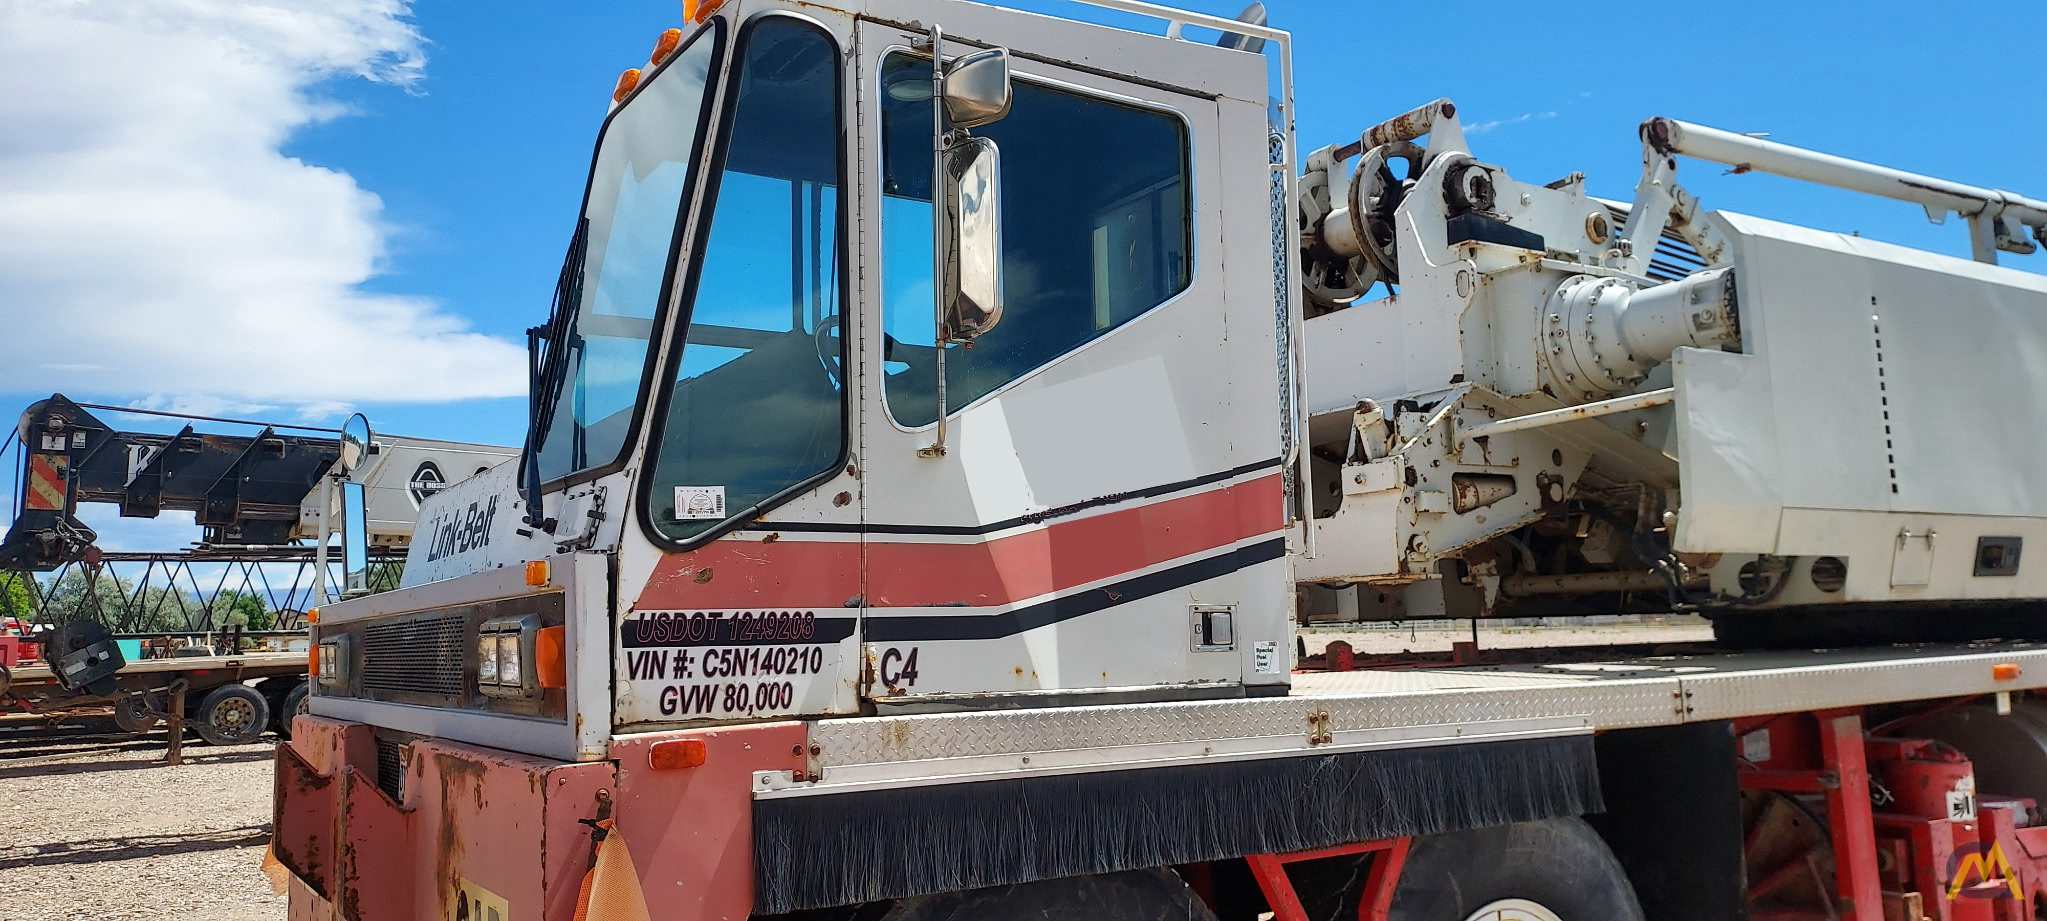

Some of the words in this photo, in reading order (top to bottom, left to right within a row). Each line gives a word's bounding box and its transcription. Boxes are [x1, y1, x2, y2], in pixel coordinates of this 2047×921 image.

[410, 481, 424, 489] THE
[427, 495, 498, 563] Link-Belt
[636, 611, 723, 643] USDOT
[728, 611, 815, 641] 1249208
[627, 649, 668, 681] VIN
[673, 649, 695, 680] #:
[702, 646, 823, 678] C5N140210
[880, 647, 919, 688] C4
[660, 683, 719, 716] GVW
[723, 681, 793, 717] 80,000
